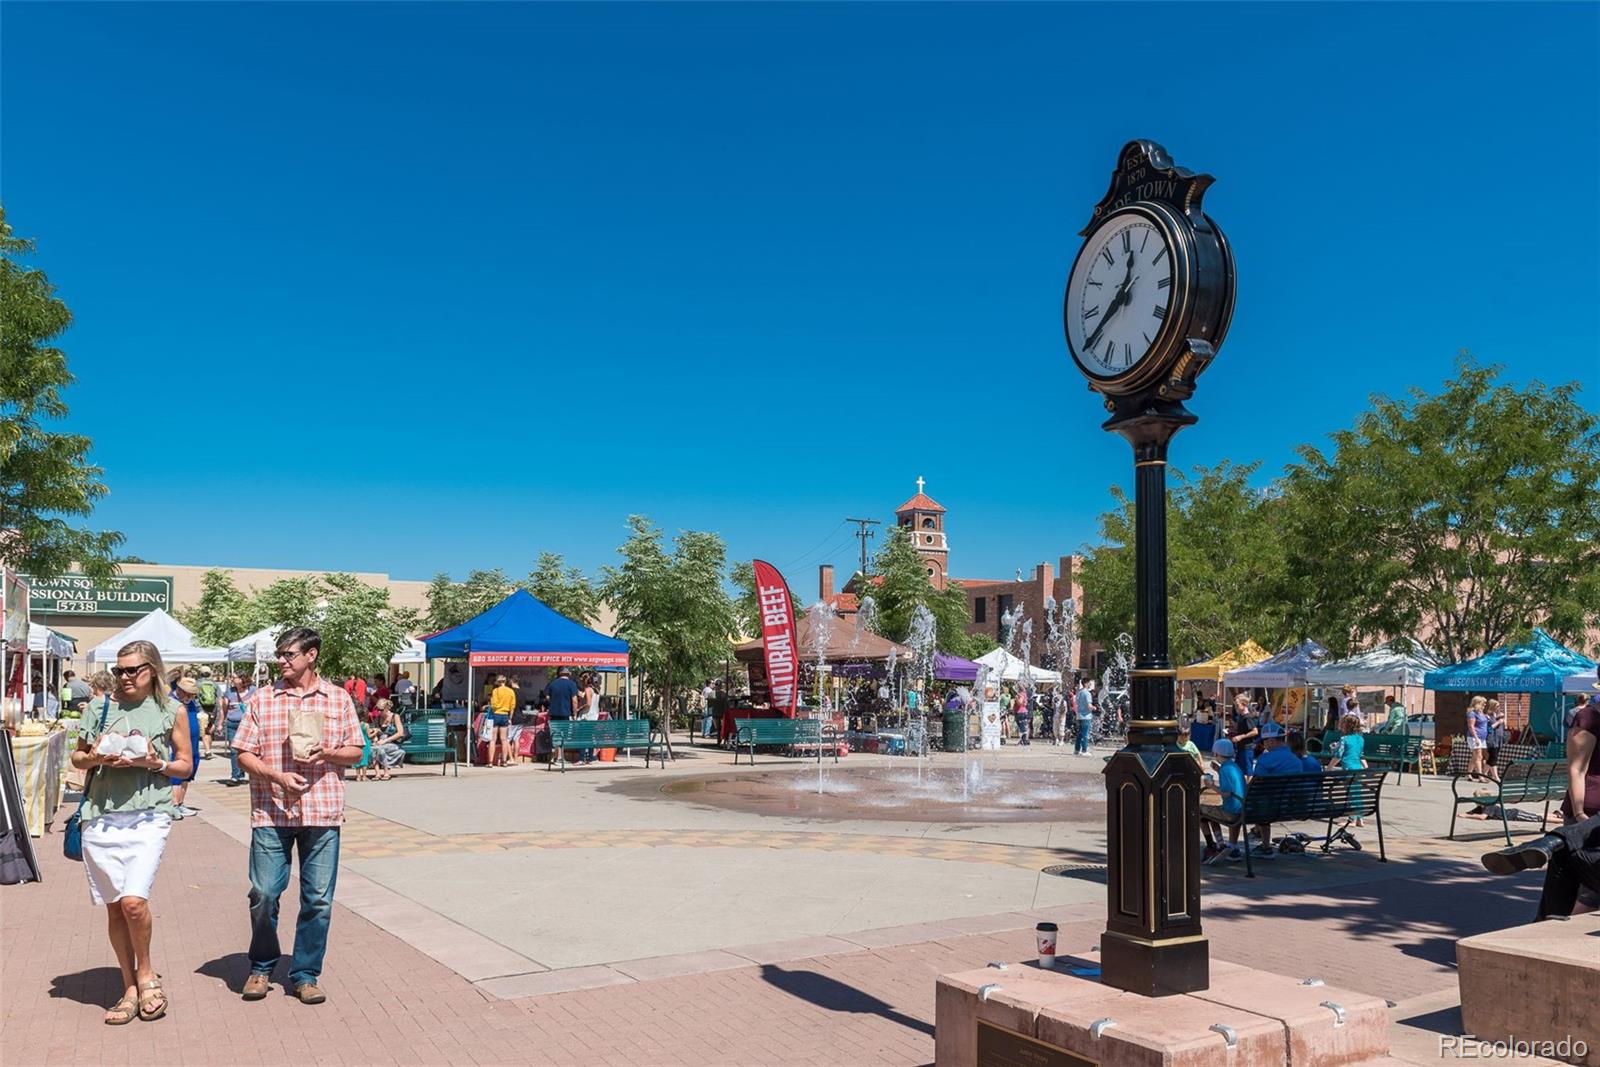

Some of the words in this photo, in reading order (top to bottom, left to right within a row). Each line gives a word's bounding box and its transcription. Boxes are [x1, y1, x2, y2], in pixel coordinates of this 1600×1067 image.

[1127, 168, 1146, 186] 1870
[1136, 180, 1177, 200] TOWN
[31, 578, 71, 588] TOWN
[98, 591, 166, 603] BUILDING
[60, 602, 95, 611] 5738
[760, 585, 788, 627] BEEF
[767, 629, 794, 708] NATURAL
[1448, 677, 1487, 687] WISCONSIN
[1489, 677, 1518, 687] CHEESE
